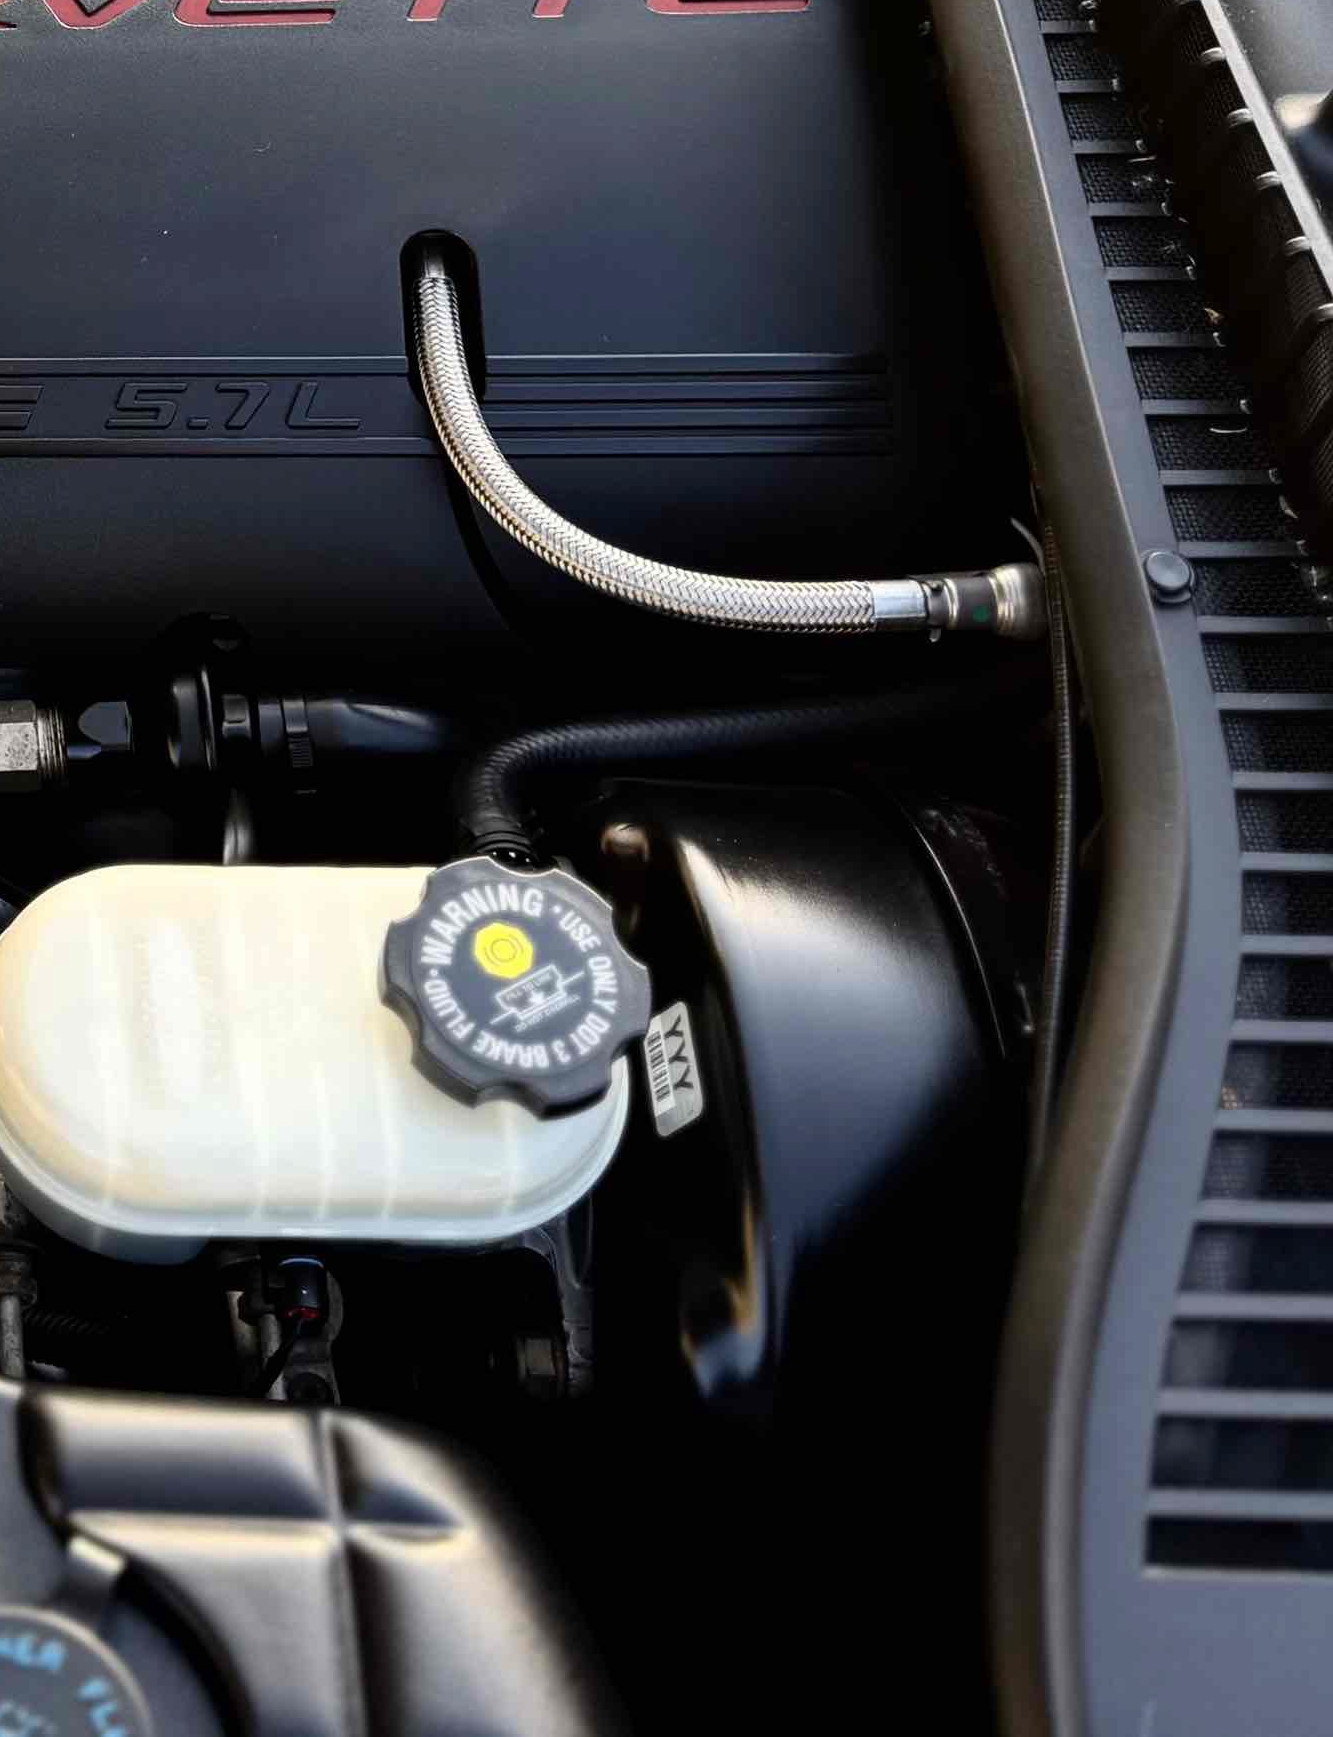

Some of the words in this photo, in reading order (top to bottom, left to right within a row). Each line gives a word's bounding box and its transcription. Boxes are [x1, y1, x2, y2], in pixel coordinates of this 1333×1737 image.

[104, 380, 366, 433] 5.7L
[421, 883, 545, 966] WARNING
[558, 909, 603, 953] USE
[423, 978, 476, 1040] FLUID
[588, 955, 619, 1016] ONLY
[472, 1030, 550, 1069] BRAKE
[551, 1041, 571, 1063] 3
[568, 1012, 613, 1060] DOT
[663, 1013, 694, 1094] YYY
